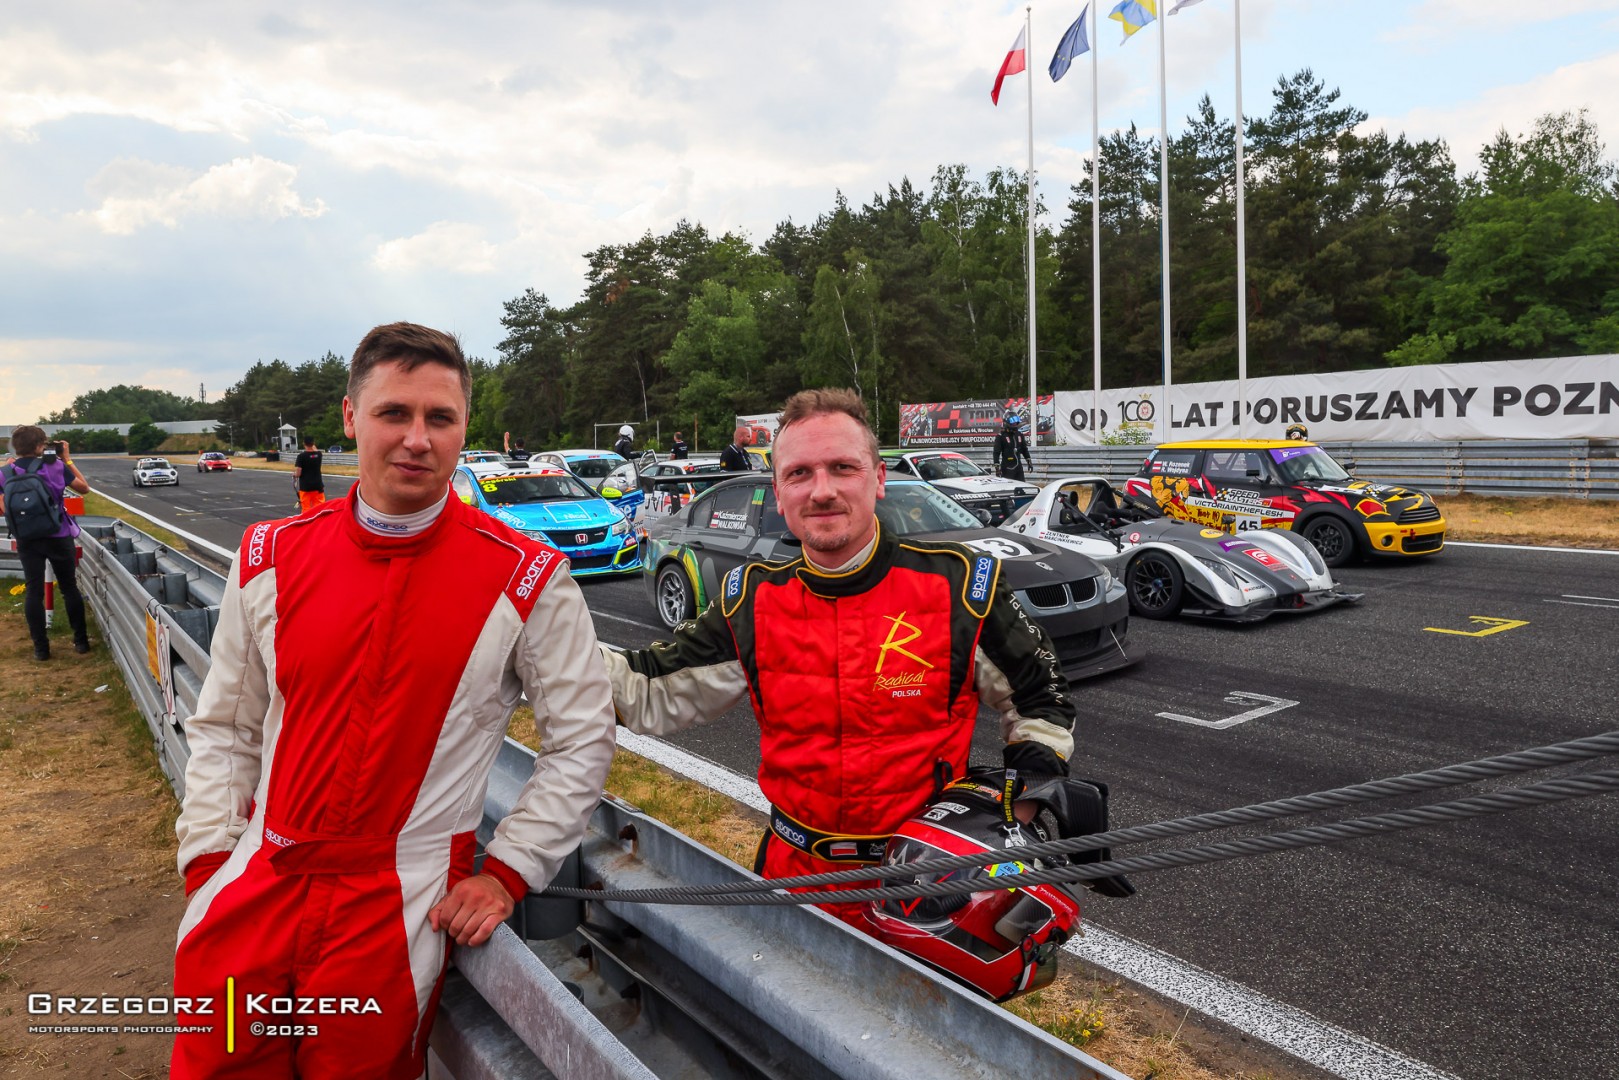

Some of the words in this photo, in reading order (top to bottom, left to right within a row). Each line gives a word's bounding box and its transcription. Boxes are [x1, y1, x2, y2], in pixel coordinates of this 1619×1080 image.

[1171, 401, 1224, 428] LAT
[1233, 387, 1478, 426] PORUSZAMY
[482, 483, 498, 493] 8
[1230, 489, 1259, 499] SPEED
[1194, 499, 1284, 518] VICTORIAINTHEFLESH
[366, 517, 409, 531] sparco
[1237, 520, 1258, 532] 45
[248, 524, 271, 567] sparco
[516, 550, 555, 600] sparco
[972, 557, 992, 600] sparco
[872, 669, 927, 692] Radical
[892, 690, 921, 698] POLSKA
[264, 827, 296, 848] sparco
[774, 818, 806, 848] sparco
